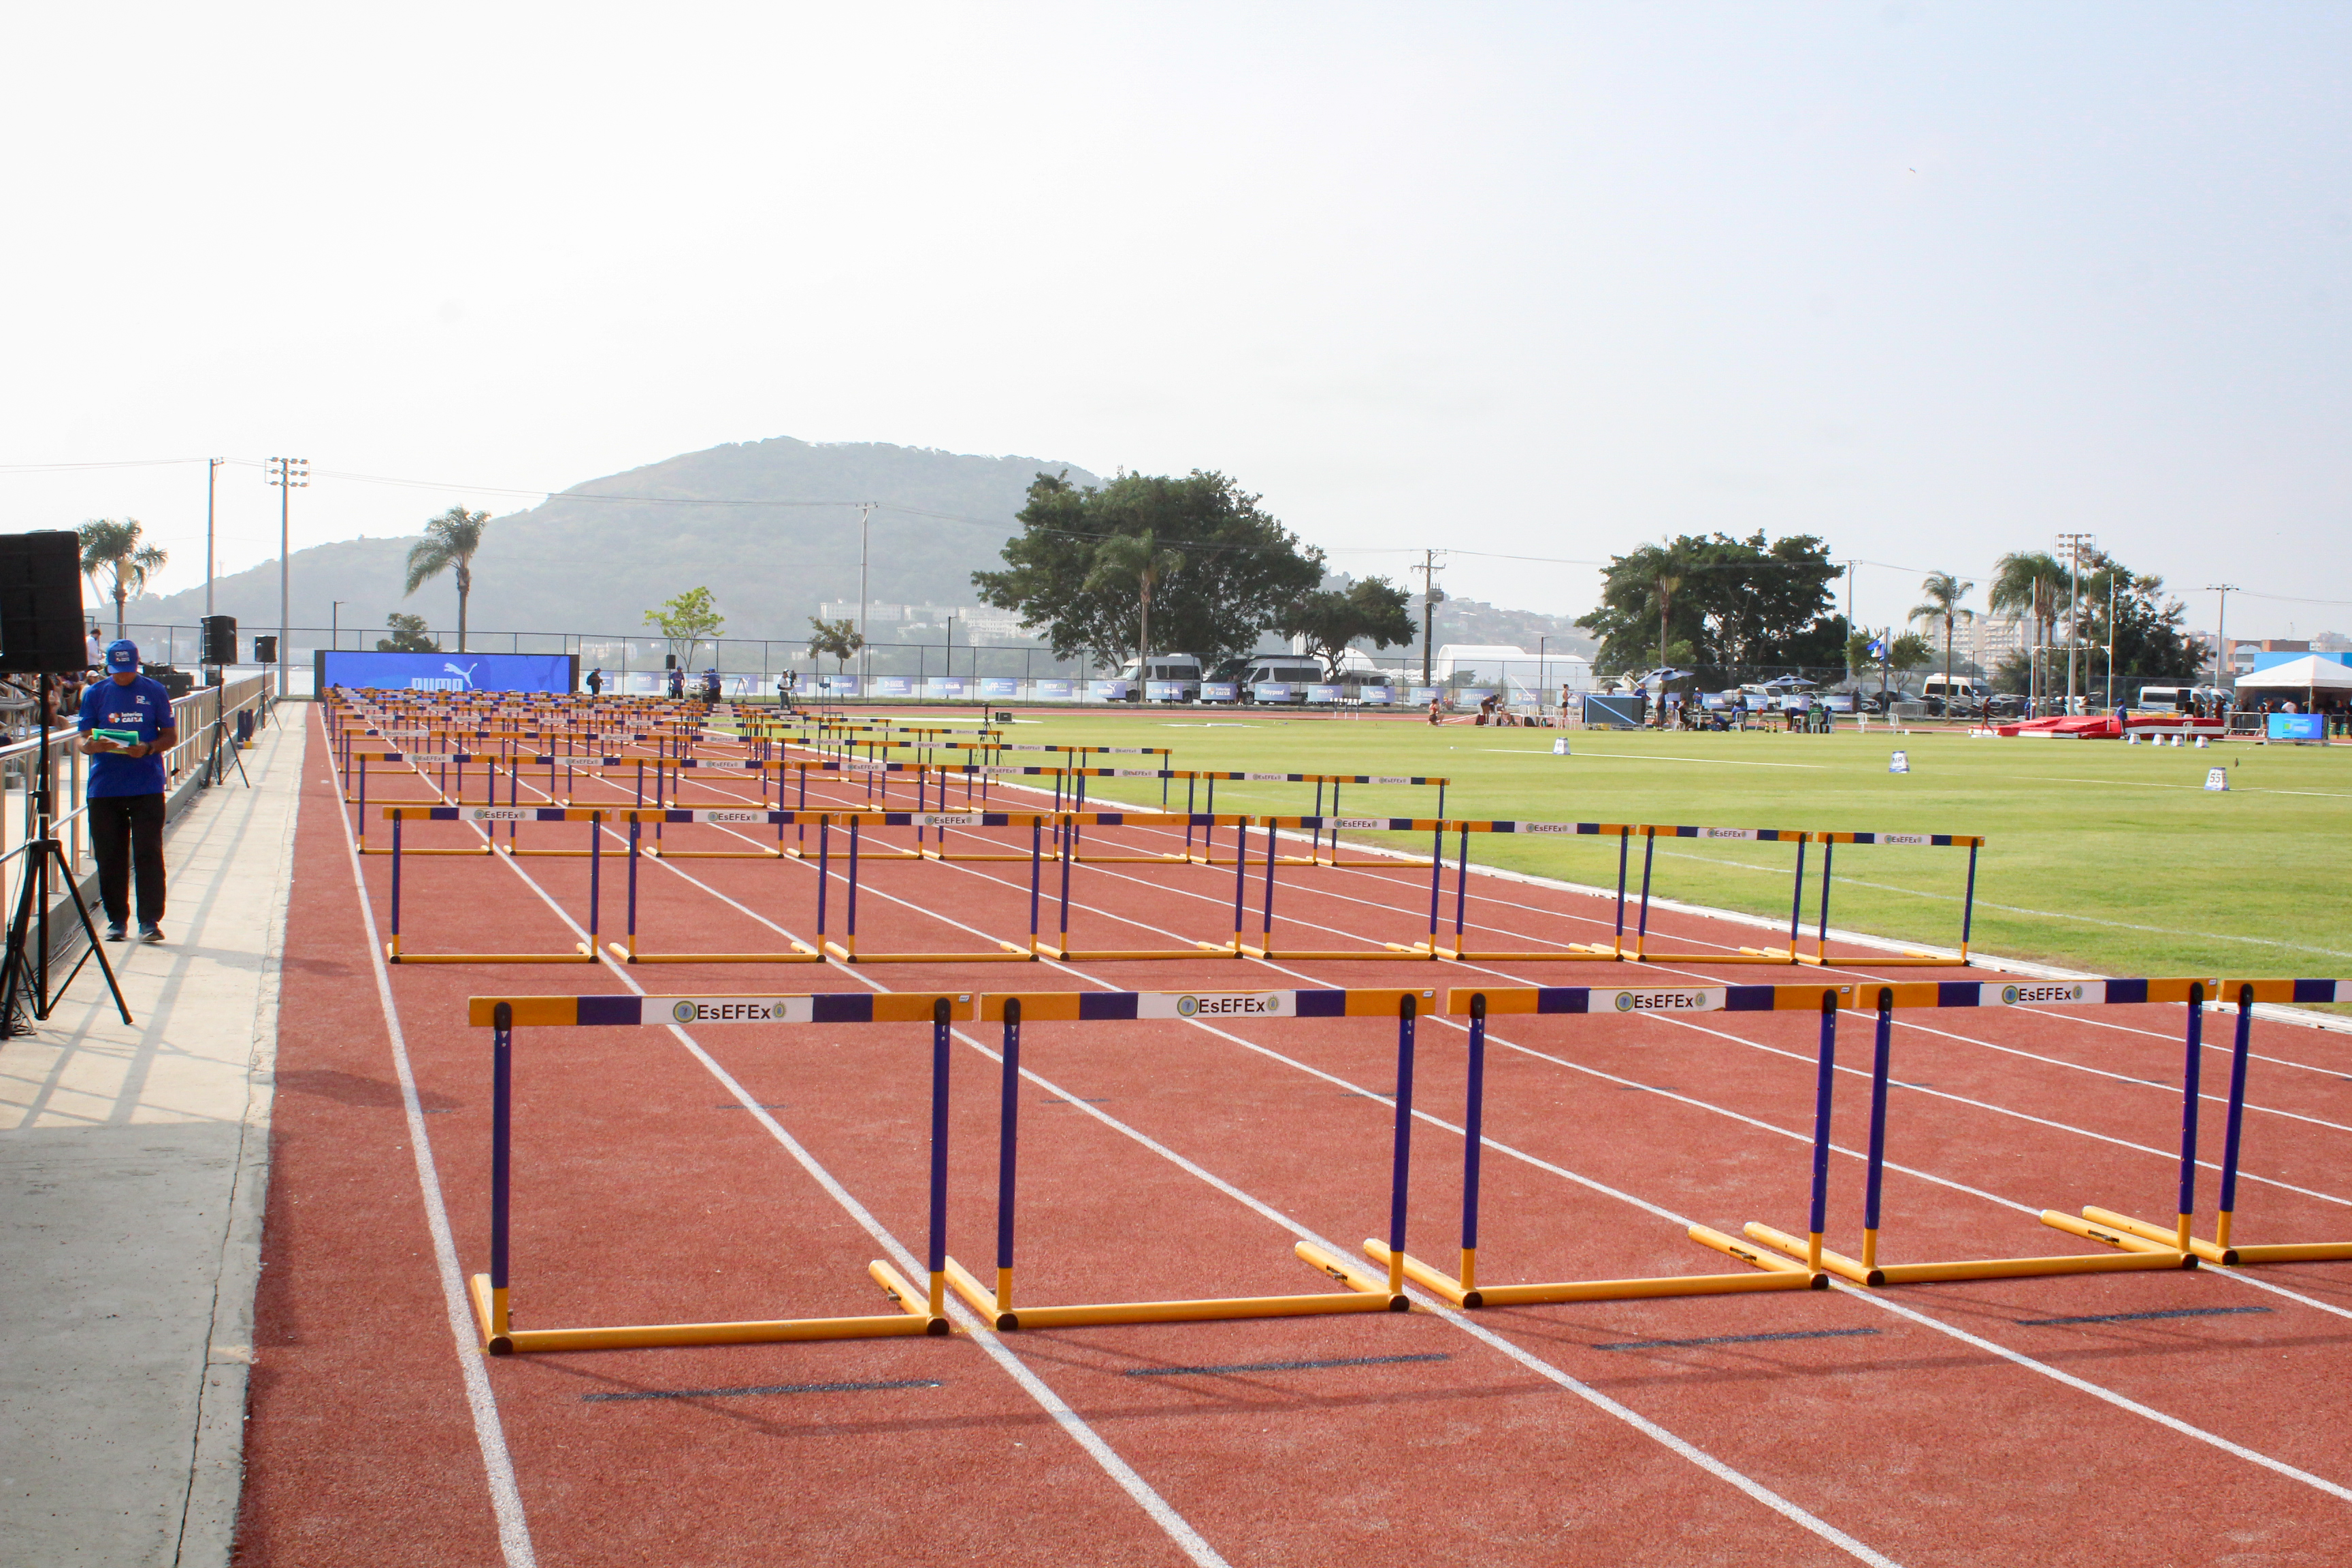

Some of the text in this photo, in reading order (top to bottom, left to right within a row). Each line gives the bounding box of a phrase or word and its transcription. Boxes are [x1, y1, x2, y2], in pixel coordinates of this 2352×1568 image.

[411, 678, 464, 691] PUMA
[2209, 773, 2221, 783] 55
[485, 811, 519, 819] EsEFEx
[1715, 830, 1742, 838] EsEFEx
[1634, 994, 1694, 1009] EsEFEx
[2019, 987, 2072, 1002] EsEFEx
[697, 1003, 771, 1020] EsEFEx
[1198, 998, 1265, 1013] EsEFEx
